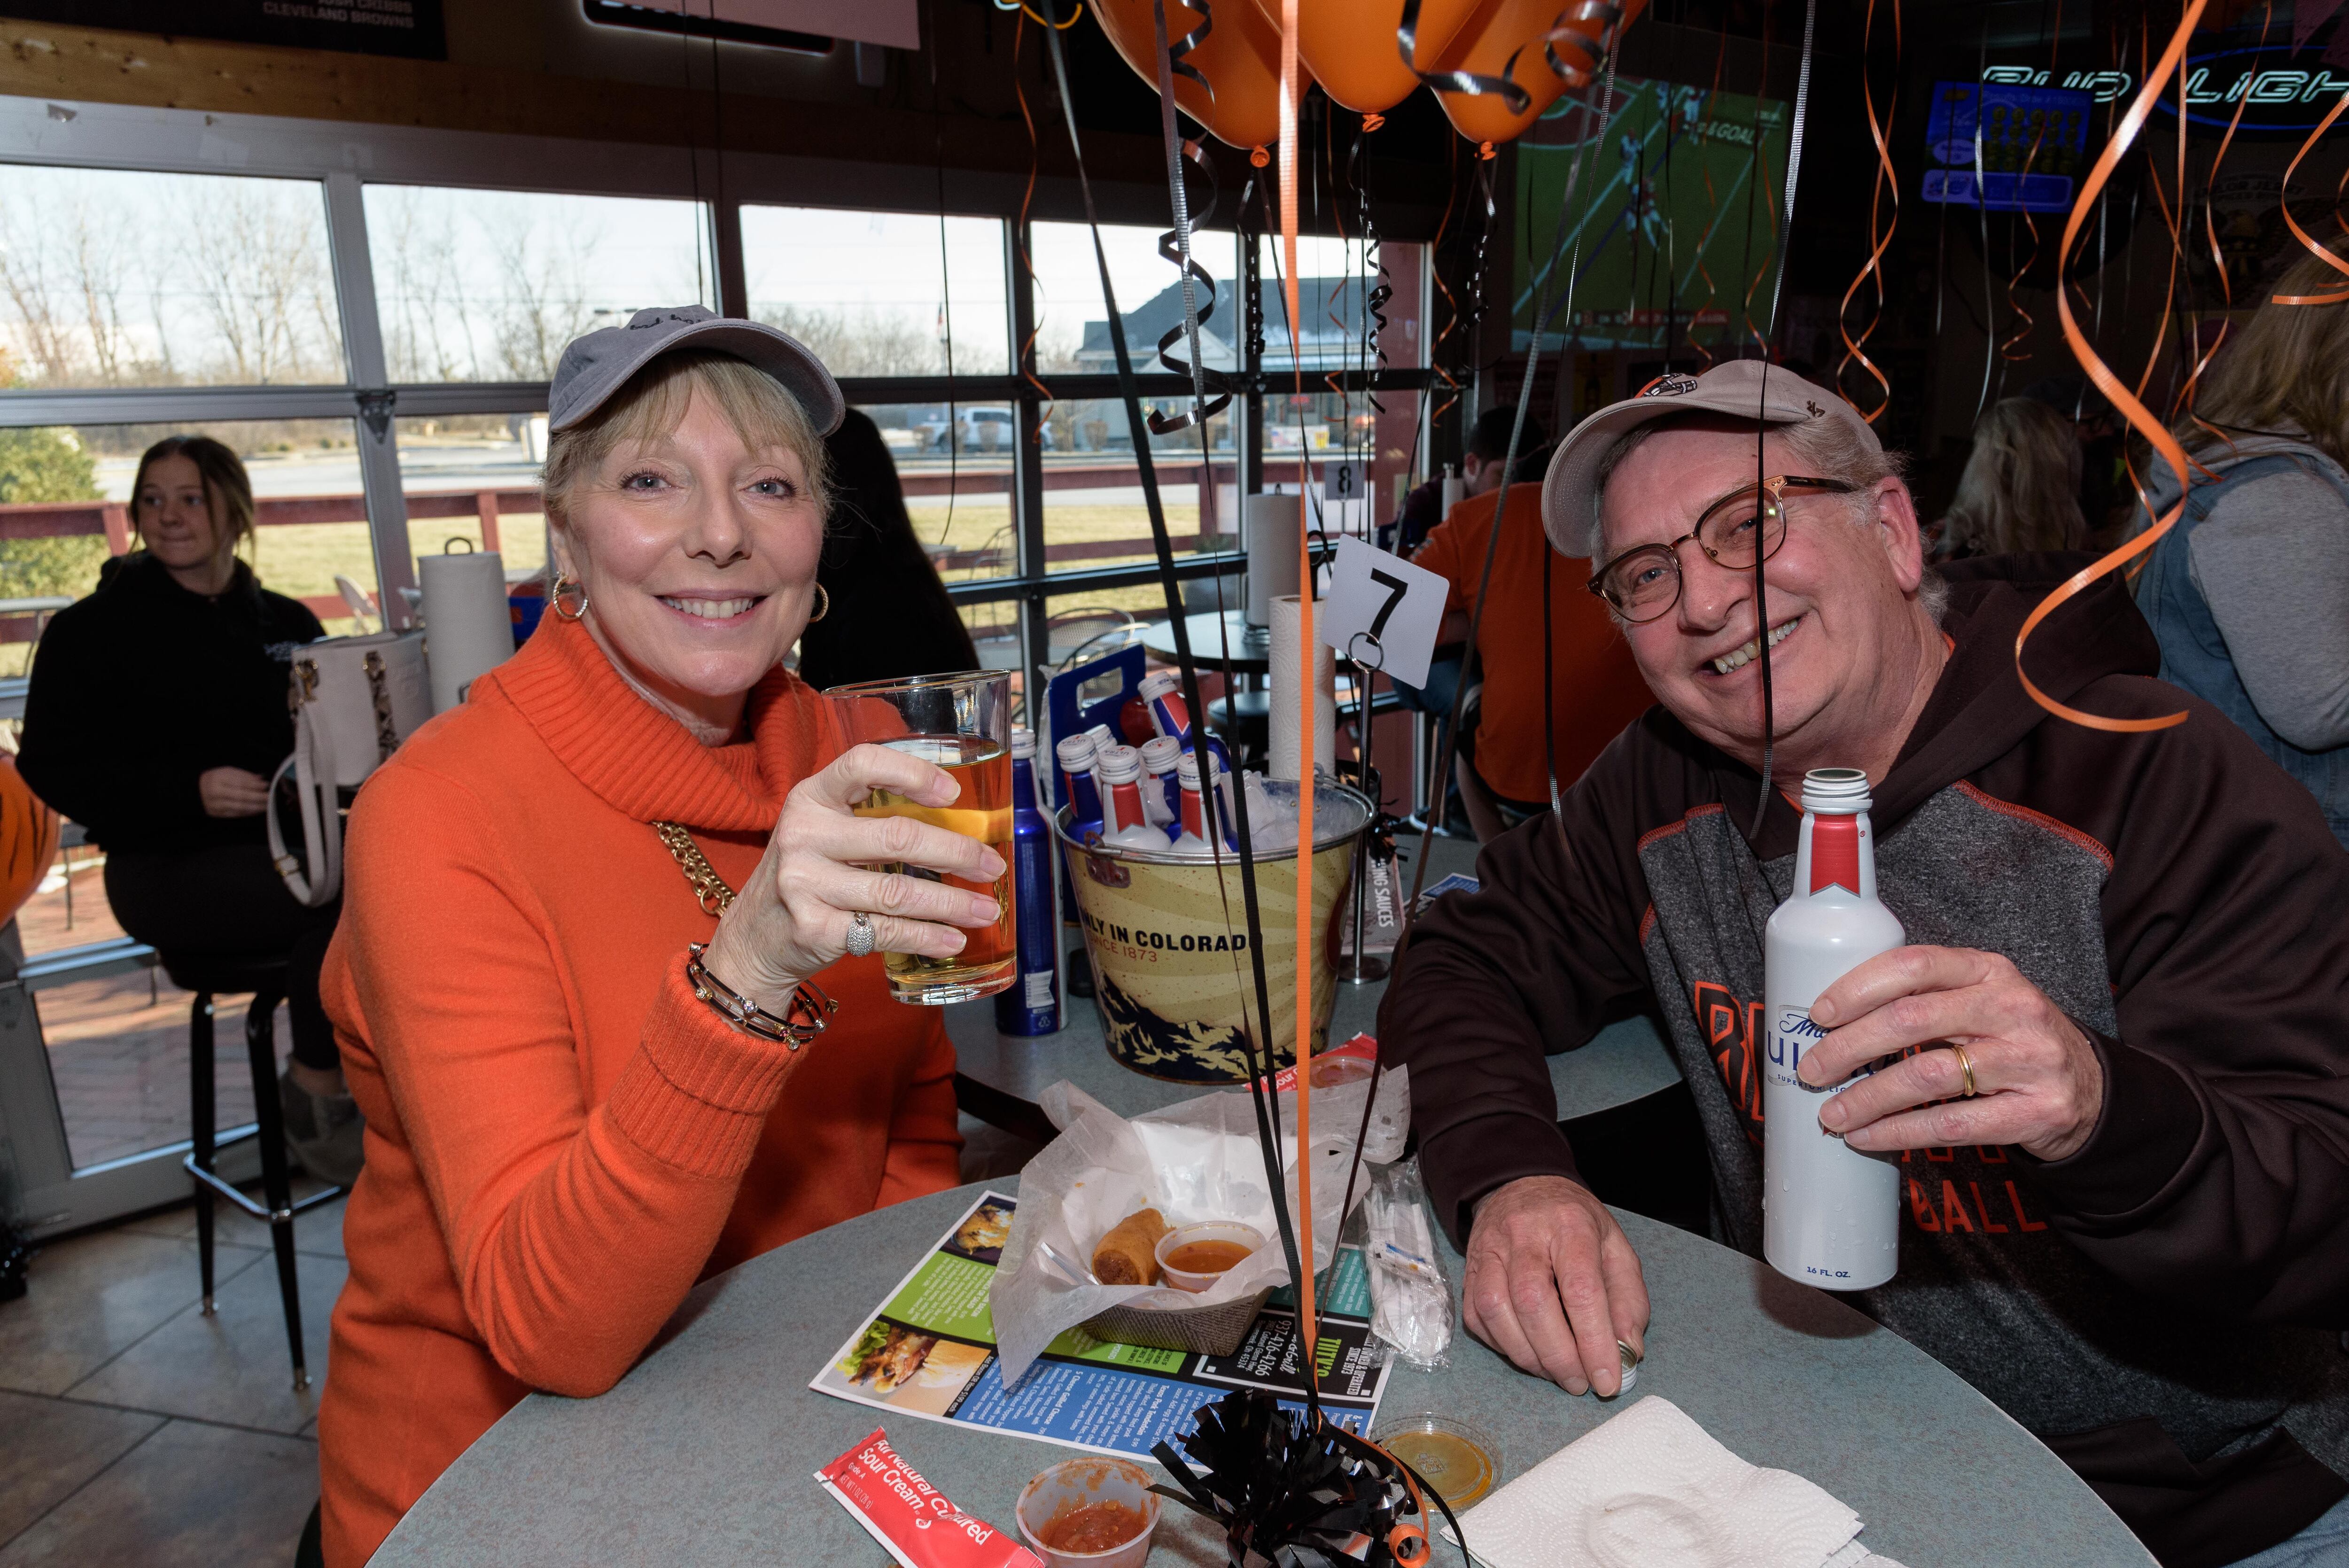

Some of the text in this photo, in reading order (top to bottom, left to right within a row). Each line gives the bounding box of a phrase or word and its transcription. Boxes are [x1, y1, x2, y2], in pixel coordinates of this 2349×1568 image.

[2184, 67, 2349, 103] LIGH
[1366, 567, 1408, 647] 7
[1375, 888, 1394, 928] SAUCES
[1110, 924, 1129, 944] IN
[1135, 930, 1262, 952] COLORAD
[1123, 946, 1158, 963] 1873
[1778, 1073, 1823, 1091] SUPERIOR
[1820, 1269, 1833, 1277] FL.
[1835, 1270, 1851, 1279] OZ.
[1257, 1331, 1272, 1347] Colonel
[1251, 1347, 1264, 1360] Glenn
[1254, 1320, 1292, 1377] 937-426-4266
[983, 1355, 995, 1364] Add
[1236, 1352, 1250, 1368] 45324
[1279, 1351, 1299, 1374] Grill
[1340, 1347, 1360, 1374] SINCE 1973
[974, 1363, 988, 1376] Bacon
[1245, 1361, 1257, 1372] Hwy.
[963, 1382, 975, 1391] Ham
[1065, 1375, 1081, 1391] Cheese
[1102, 1385, 1112, 1393] side
[1114, 1377, 1127, 1392] toasted
[1124, 1379, 1137, 1394] tomato,
[1346, 1370, 1365, 1396] OPERATED
[955, 1391, 968, 1402] $1.99
[980, 1390, 991, 1401] onion
[1021, 1389, 1037, 1405] Cheddar
[1023, 1367, 1062, 1419] American, Swiss, Mozzarella,
[1030, 1368, 1072, 1425] Buttery, Grilled Texas toast with
[1054, 1391, 1070, 1408] Grilled
[1088, 1388, 1099, 1399] onion
[1095, 1393, 1107, 1406] salad,
[971, 1401, 984, 1412] rings
[1008, 1395, 1022, 1407] Ghost
[1081, 1399, 1092, 1410] rings
[1117, 1394, 1128, 1406] onion,
[1168, 1400, 1178, 1409] Add
[1190, 1400, 1200, 1409] side
[948, 1402, 960, 1413] each
[978, 1401, 996, 1420] seasoned
[992, 1406, 1003, 1415] with
[998, 1407, 1014, 1421] Pepper
[1101, 1401, 1115, 1415] Served
[1108, 1407, 1121, 1421] pickle,
[1121, 1382, 1157, 1438] Thinly sliced, deep fried pork
[1162, 1409, 1172, 1417] egg
[1176, 1403, 1188, 1415] onion
[965, 1412, 977, 1421] with
[985, 1414, 996, 1424] your
[1043, 1407, 1060, 1425] Cheese
[1077, 1410, 1087, 1419] with
[1084, 1405, 1100, 1425] seasoned
[1096, 1415, 1107, 1424] with
[1105, 1381, 1147, 1448] tenderloin topped with crisp lettuce,
[1129, 1384, 1170, 1447] Texas Pork Tenderloin 8.99
[1170, 1415, 1182, 1426] rings
[1069, 1419, 1081, 1430] bistro
[1078, 1425, 1089, 1435] fries,
[1090, 1424, 1100, 1434] your
[1099, 1425, 1111, 1437] mayo
[1154, 1422, 1166, 1436] cheese
[1167, 1426, 1176, 1435] with
[1084, 1434, 1096, 1445] choic
[858, 1448, 926, 1511] Sour Cream
[887, 1451, 933, 1498] Natural
[839, 1474, 850, 1485] NET
[846, 1479, 856, 1491] WT
[855, 1487, 863, 1498] OZ
[859, 1492, 869, 1504] (28
